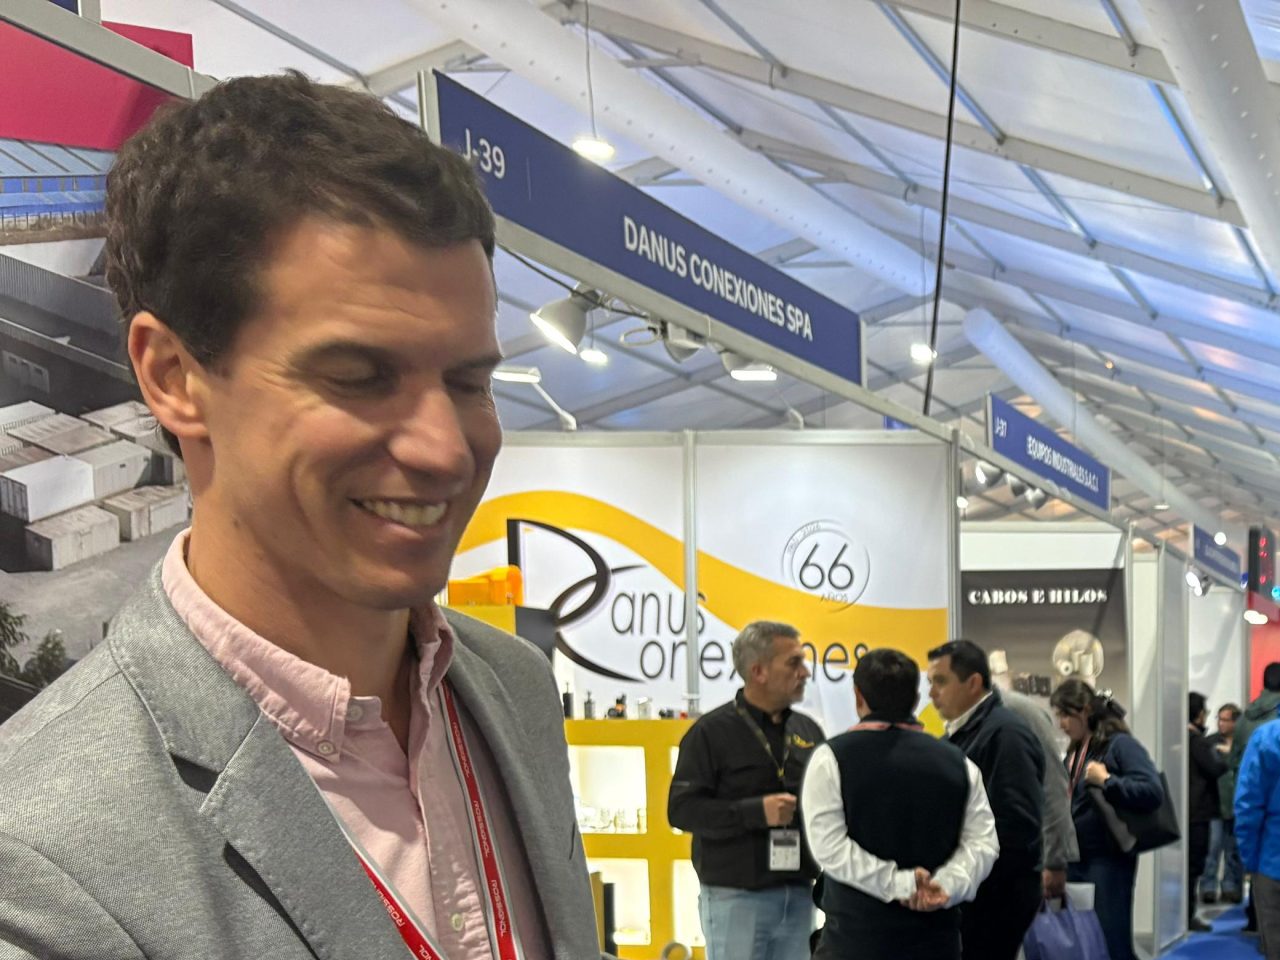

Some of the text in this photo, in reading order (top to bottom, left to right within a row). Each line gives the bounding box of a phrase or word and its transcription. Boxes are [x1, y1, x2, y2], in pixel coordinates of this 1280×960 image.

[463, 128, 505, 179] J-39
[624, 215, 813, 342] DANUS CONEXIONES SPA
[799, 542, 854, 590] 66
[968, 589, 1108, 605] CABOS E HILOS
[474, 800, 489, 857] ROSSIGNOL
[491, 880, 507, 938] ROSSIGNOL
